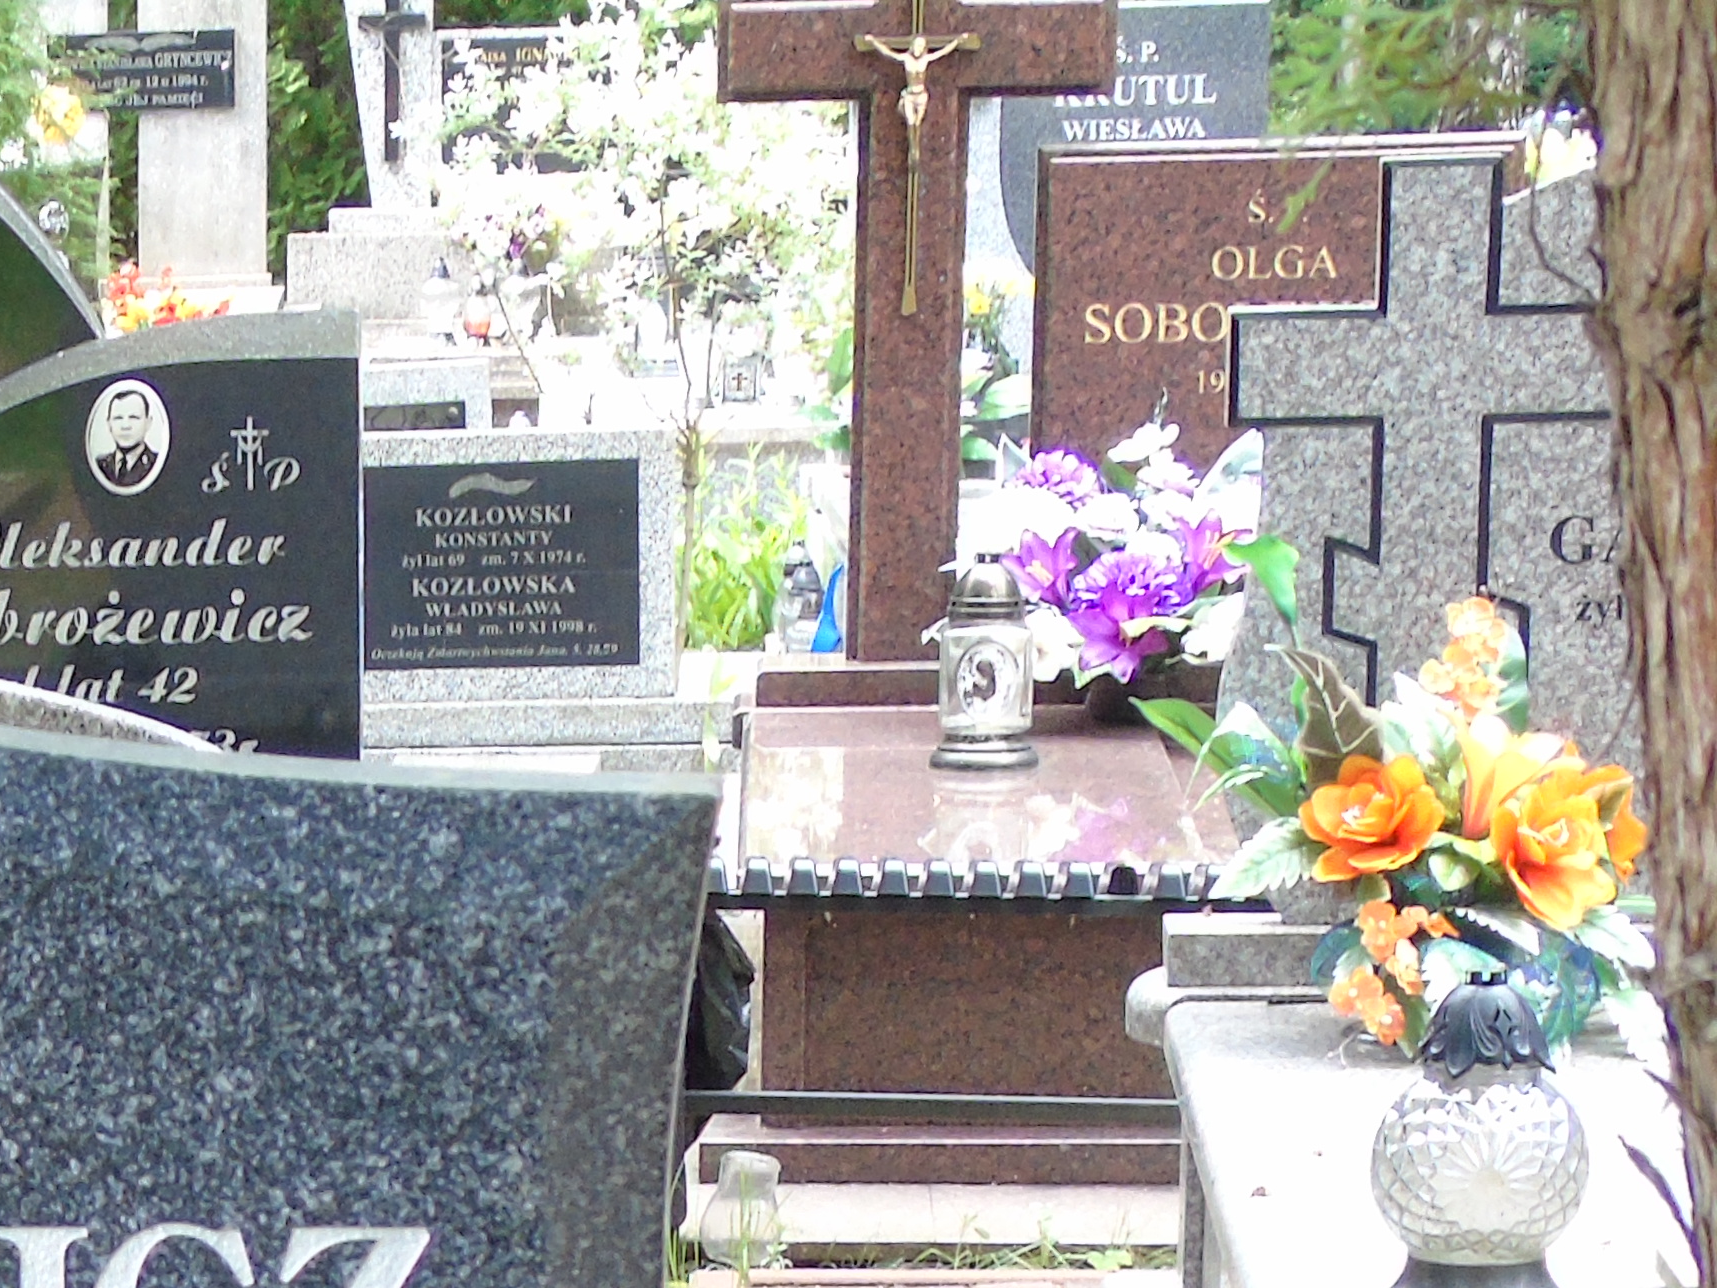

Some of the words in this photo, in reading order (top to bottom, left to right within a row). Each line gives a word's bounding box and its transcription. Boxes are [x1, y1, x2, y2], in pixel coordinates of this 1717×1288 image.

[1140, 41, 1159, 62] P.
[1062, 116, 1206, 142] WIESŁAWA
[1211, 246, 1338, 280] OLGA
[1084, 302, 1229, 345] SOBO
[1197, 369, 1225, 394] 19
[415, 504, 573, 528] KOZŁOWSKI
[435, 530, 554, 549] KONSTANTY
[412, 574, 577, 598] KOZŁOWSKA
[425, 600, 563, 618] WŁADYSŁAWA
[138, 665, 200, 705] 42
